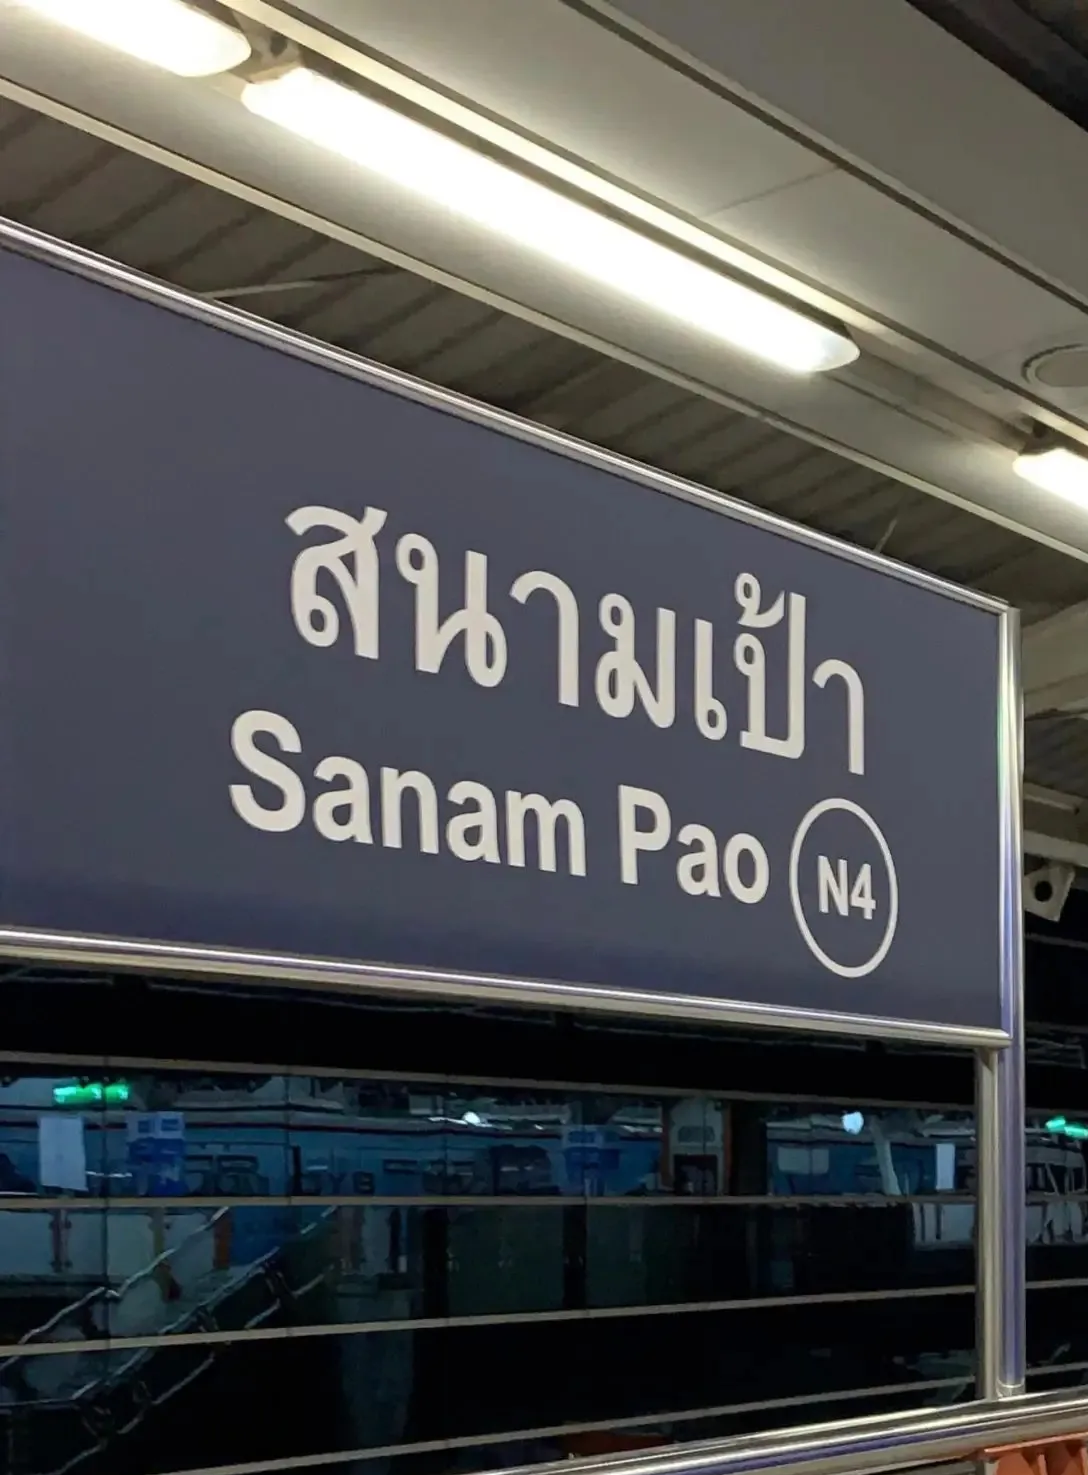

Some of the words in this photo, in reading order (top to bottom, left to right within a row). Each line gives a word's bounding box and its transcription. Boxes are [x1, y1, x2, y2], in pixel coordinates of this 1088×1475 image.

[285, 506, 866, 775] สนามเป้า
[230, 710, 586, 877] Sanam
[619, 785, 770, 904] Pao
[817, 856, 876, 920] N4
